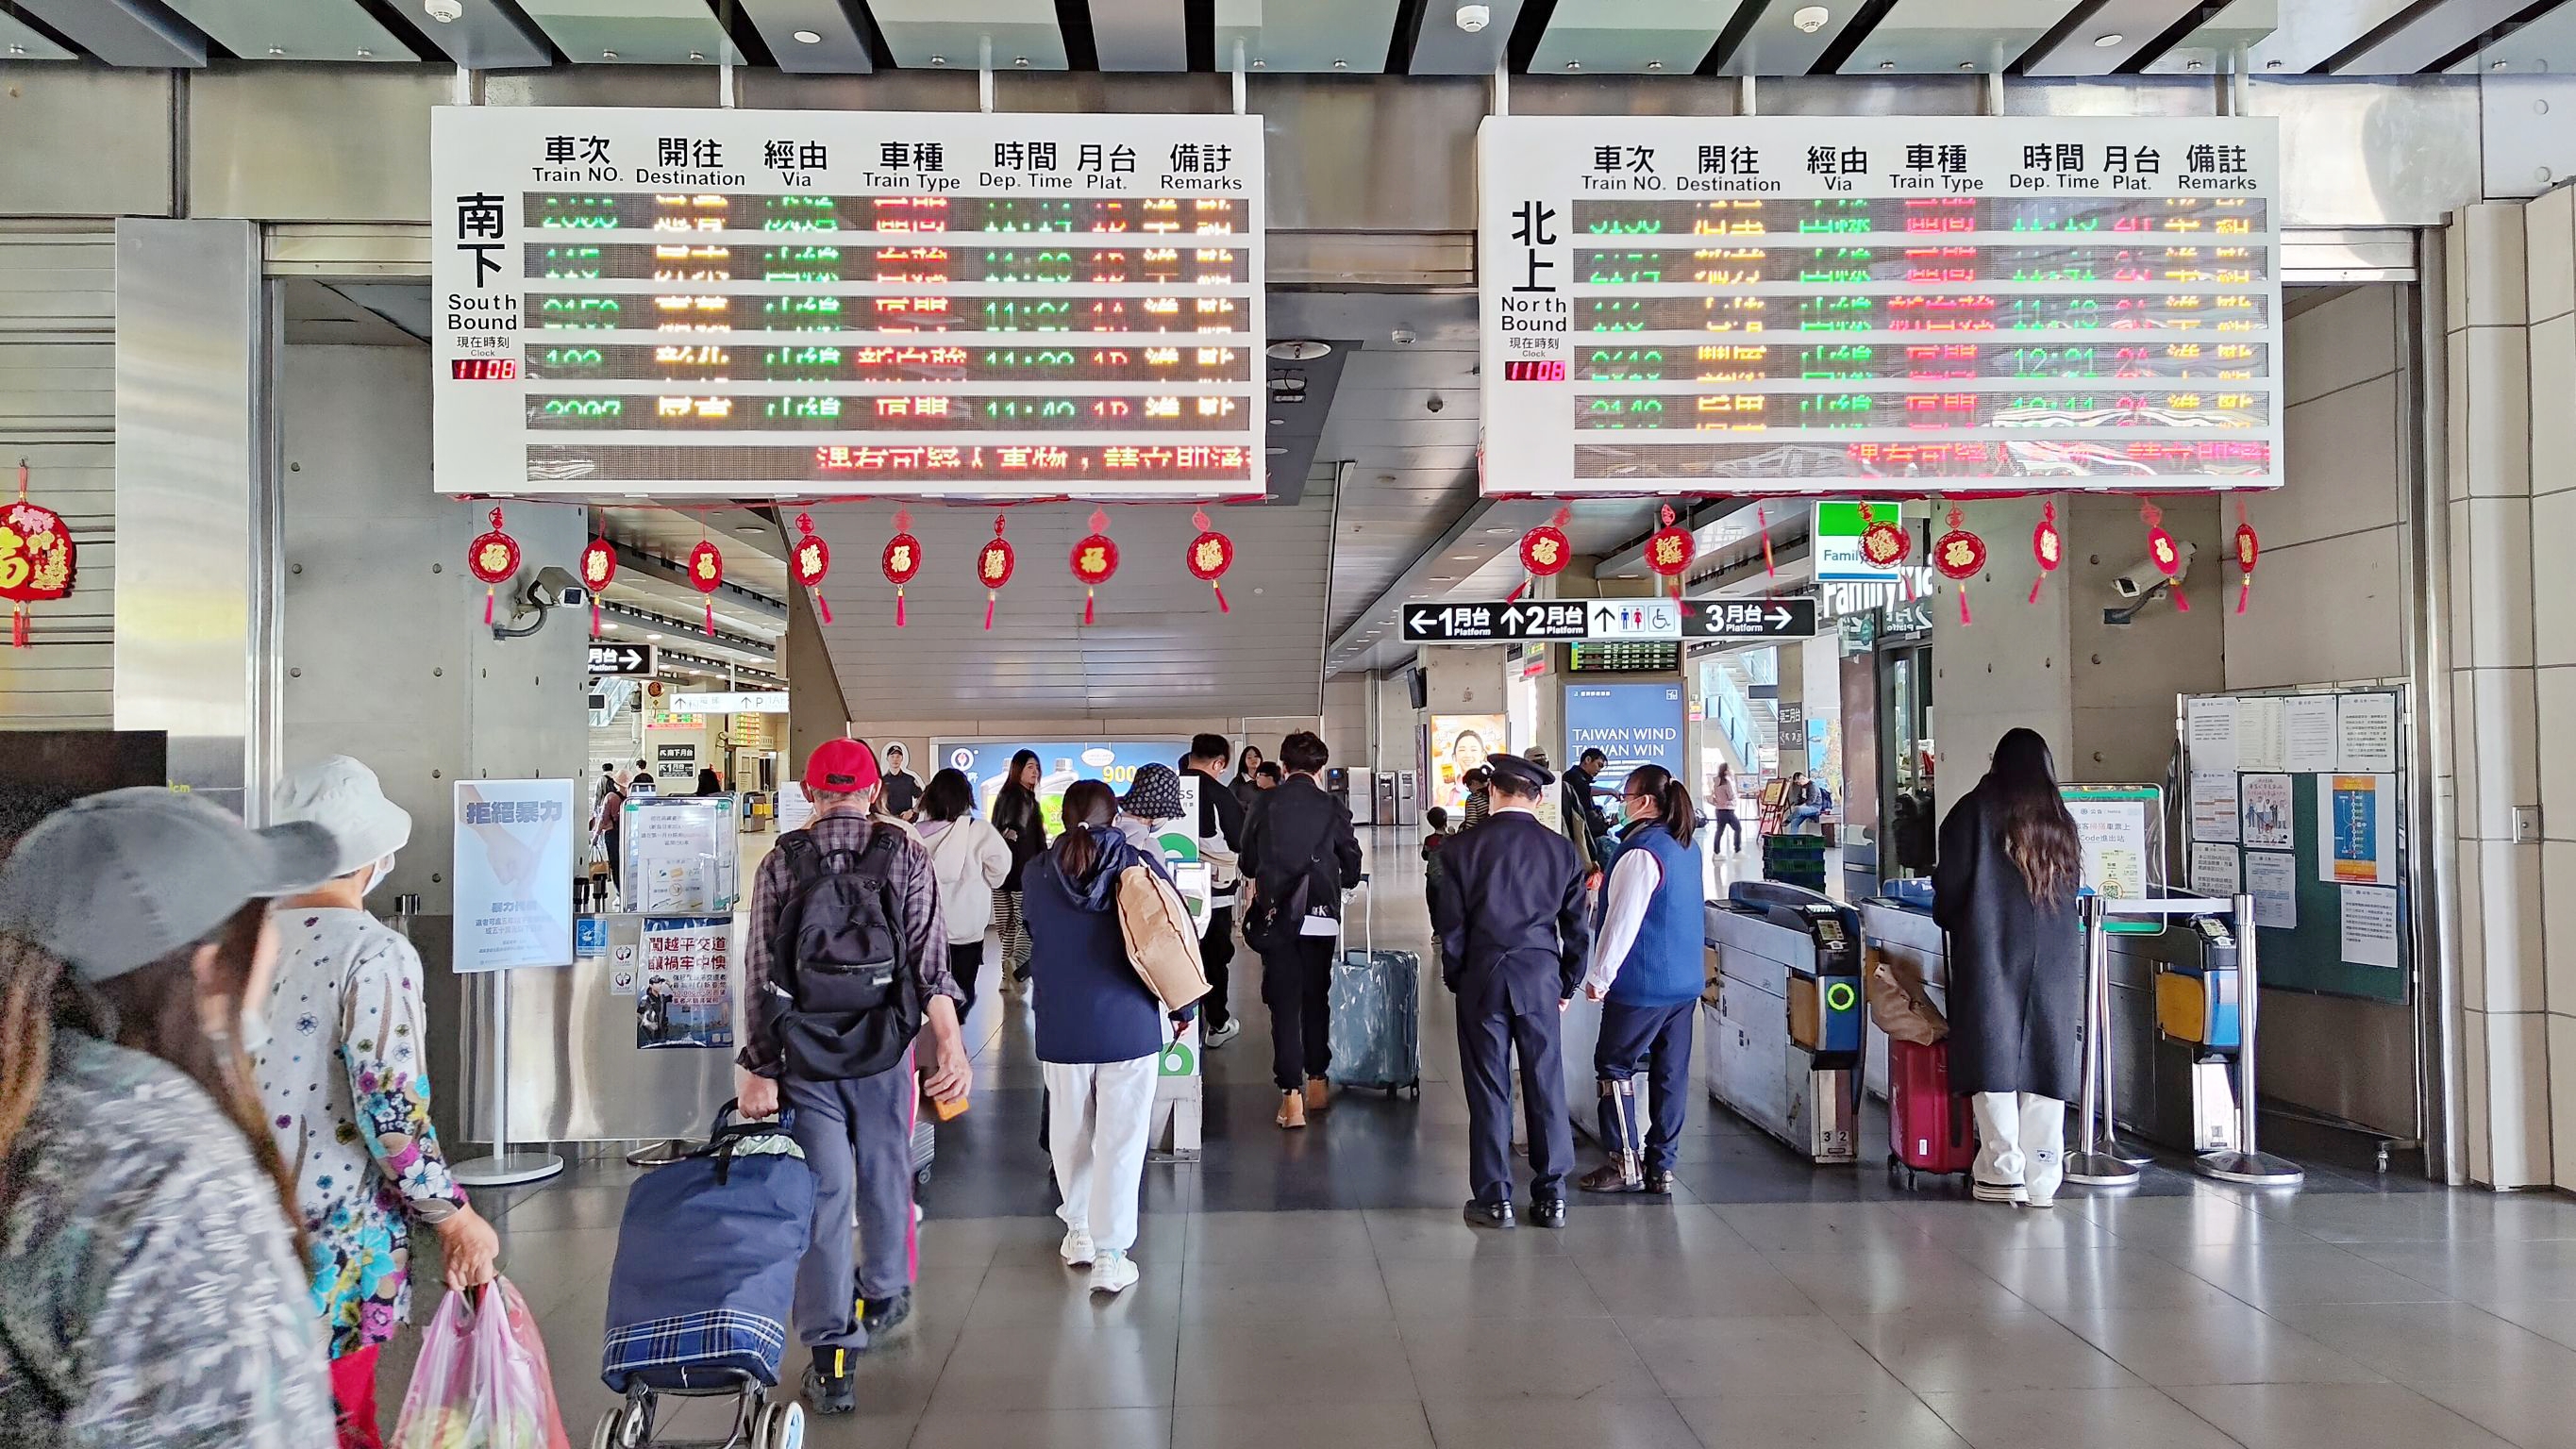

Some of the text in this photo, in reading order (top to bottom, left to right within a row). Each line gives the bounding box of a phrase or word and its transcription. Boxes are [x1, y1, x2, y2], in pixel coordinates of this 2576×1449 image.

[544, 134, 611, 165] 車次
[658, 137, 724, 169] 開往
[763, 139, 828, 171] 經由
[879, 141, 945, 172] 車種
[994, 141, 1057, 172] 時間
[1077, 143, 1137, 174] 月台
[1169, 142, 1232, 174] 備註
[1905, 142, 1967, 174] 車種
[2023, 142, 2084, 173] 時間
[1593, 144, 1655, 175] 車次
[1698, 144, 1760, 175] 開往
[1806, 145, 1867, 175] 經由
[2102, 144, 2161, 175] 月台
[2185, 143, 2248, 175] 備註
[531, 166, 624, 182] Train NO.
[636, 168, 745, 187] Destination
[781, 172, 811, 188] Via
[861, 172, 961, 193] Train Type
[979, 172, 1073, 192] Dep. Time
[1086, 174, 1128, 191] Plat.
[1161, 174, 1243, 191] Remarks
[2009, 174, 2099, 192] Dep. Time
[2113, 175, 2152, 191] Plat.
[2178, 175, 2257, 191] Remarks
[1581, 175, 1666, 192] Train NO.
[1677, 175, 1781, 192] Destination
[1823, 175, 1852, 192] Via
[1888, 174, 1984, 193] Train Type
[456, 192, 506, 289] 南下
[1511, 200, 1558, 293] 北上
[447, 293, 517, 310] South
[1501, 295, 1566, 313] North
[447, 313, 517, 331] Bound
[1501, 315, 1567, 333] Bound
[456, 335, 510, 349] 現在時刻
[1509, 337, 1560, 350] 現在時刻
[470, 349, 496, 358] Clock
[1521, 349, 1547, 358] Clock
[890, 545, 912, 573] 福
[1531, 536, 1560, 565] 福
[1655, 535, 1683, 566] 新年快樂
[1944, 540, 1976, 568] 福
[1453, 627, 1492, 637] Platform
[1546, 626, 1584, 635] Platform
[1726, 624, 1764, 633] Platform
[589, 648, 619, 664] 月台
[1571, 727, 1677, 741] TAIWAN WIND
[1571, 744, 1664, 757] TAWAN WIN
[466, 799, 563, 824] 拒絕暴力
[648, 936, 727, 953] 闖越平交道
